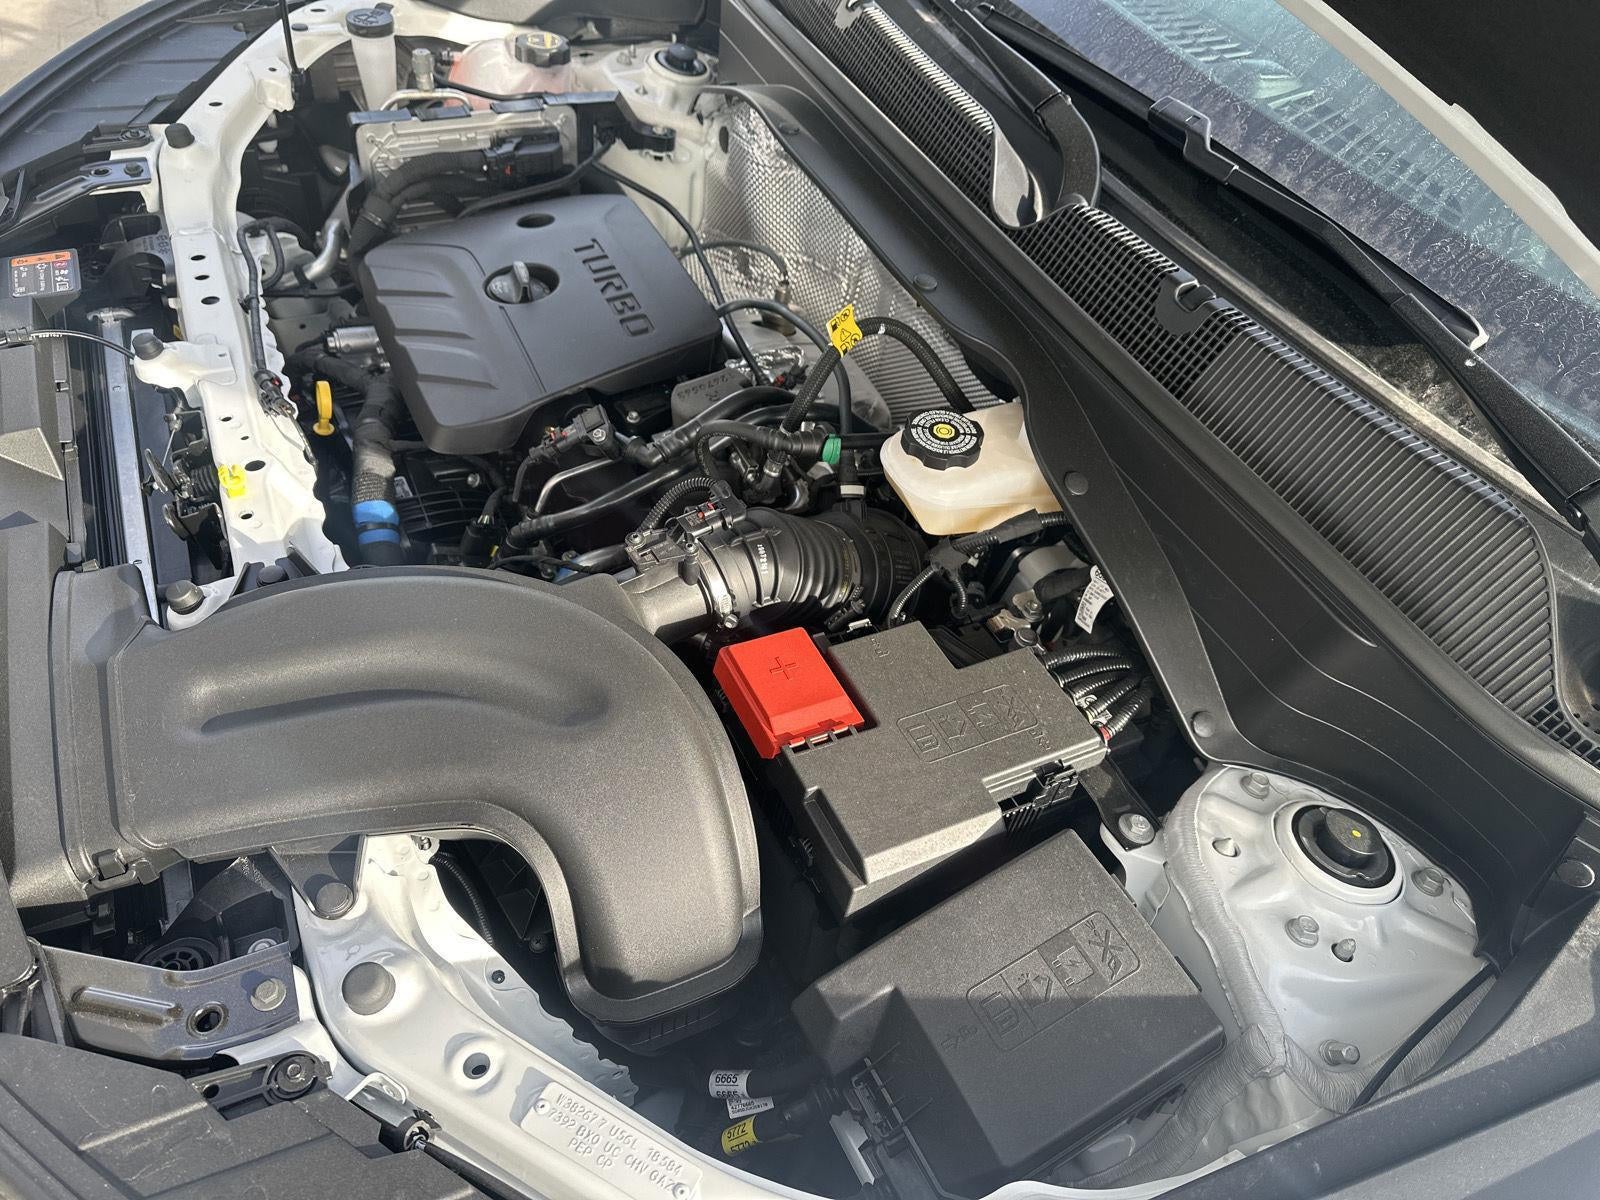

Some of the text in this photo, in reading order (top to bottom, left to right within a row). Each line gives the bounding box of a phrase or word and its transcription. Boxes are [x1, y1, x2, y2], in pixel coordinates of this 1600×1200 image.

[573, 238, 656, 338] TURBO
[715, 1073, 738, 1084] 6665
[727, 1122, 748, 1139] 5772
